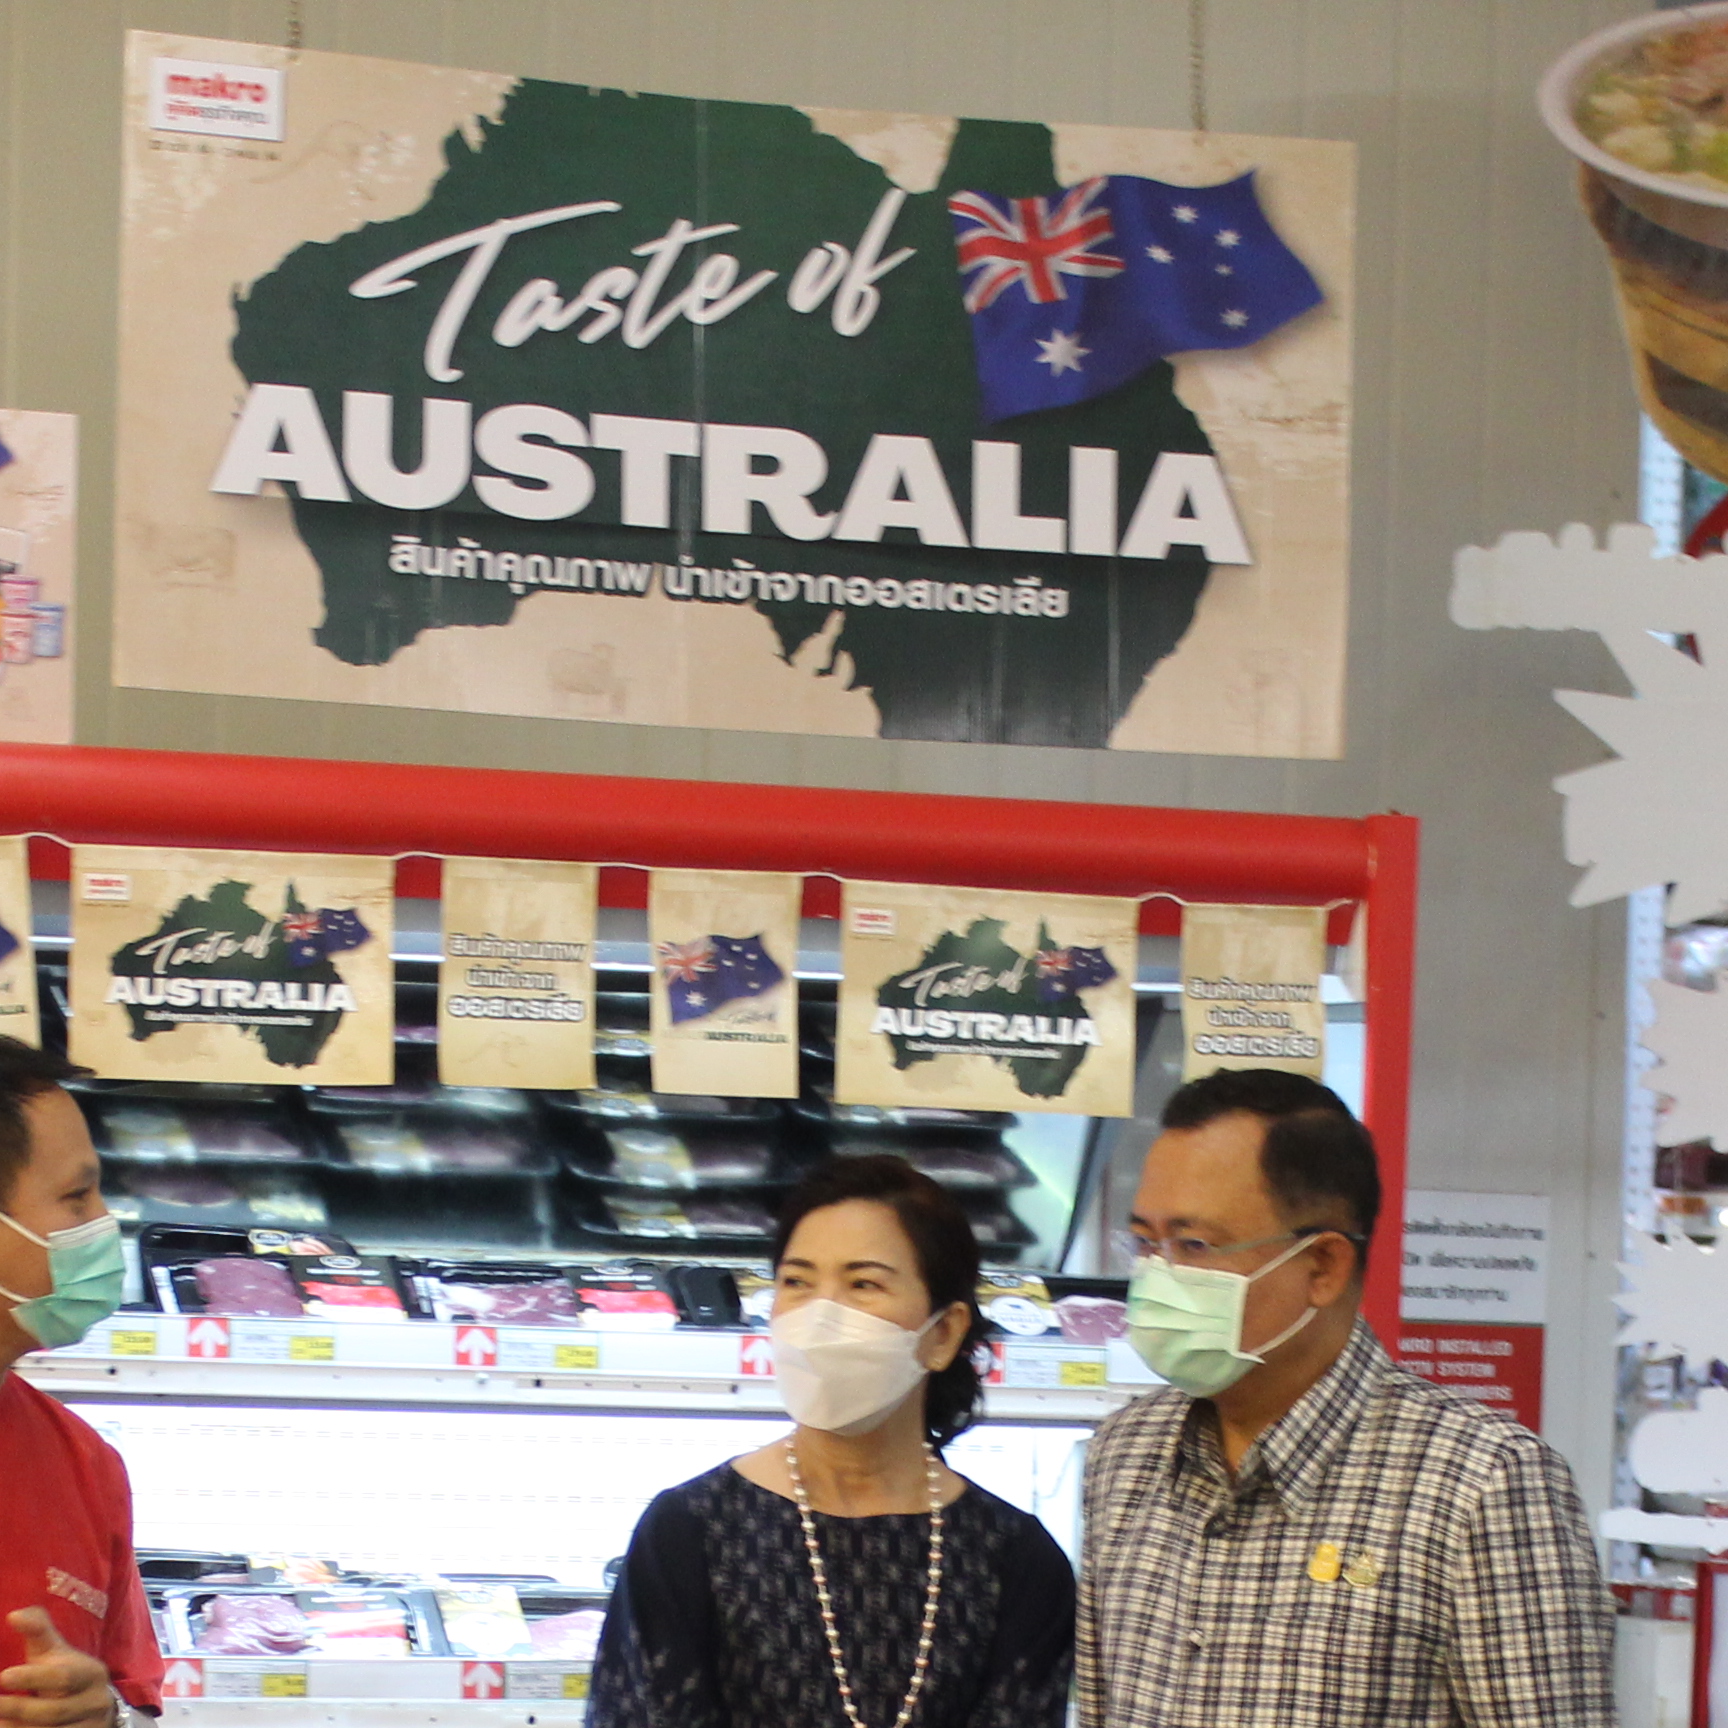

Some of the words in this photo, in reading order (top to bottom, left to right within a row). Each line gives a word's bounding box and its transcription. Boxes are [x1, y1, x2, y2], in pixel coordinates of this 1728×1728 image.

[166, 72, 267, 103] makro
[351, 200, 781, 383] Taste
[787, 186, 915, 338] of
[210, 383, 1253, 566] AUSTRALIA
[388, 535, 652, 595] สินค้าคุณภาพ
[665, 554, 1070, 618] นำเข้าจากออสเตรเลีย
[105, 976, 358, 1012] AUSTRALIA
[871, 1006, 1102, 1046] AUSTRALIA
[1436, 1338, 1513, 1356] INSTALLED
